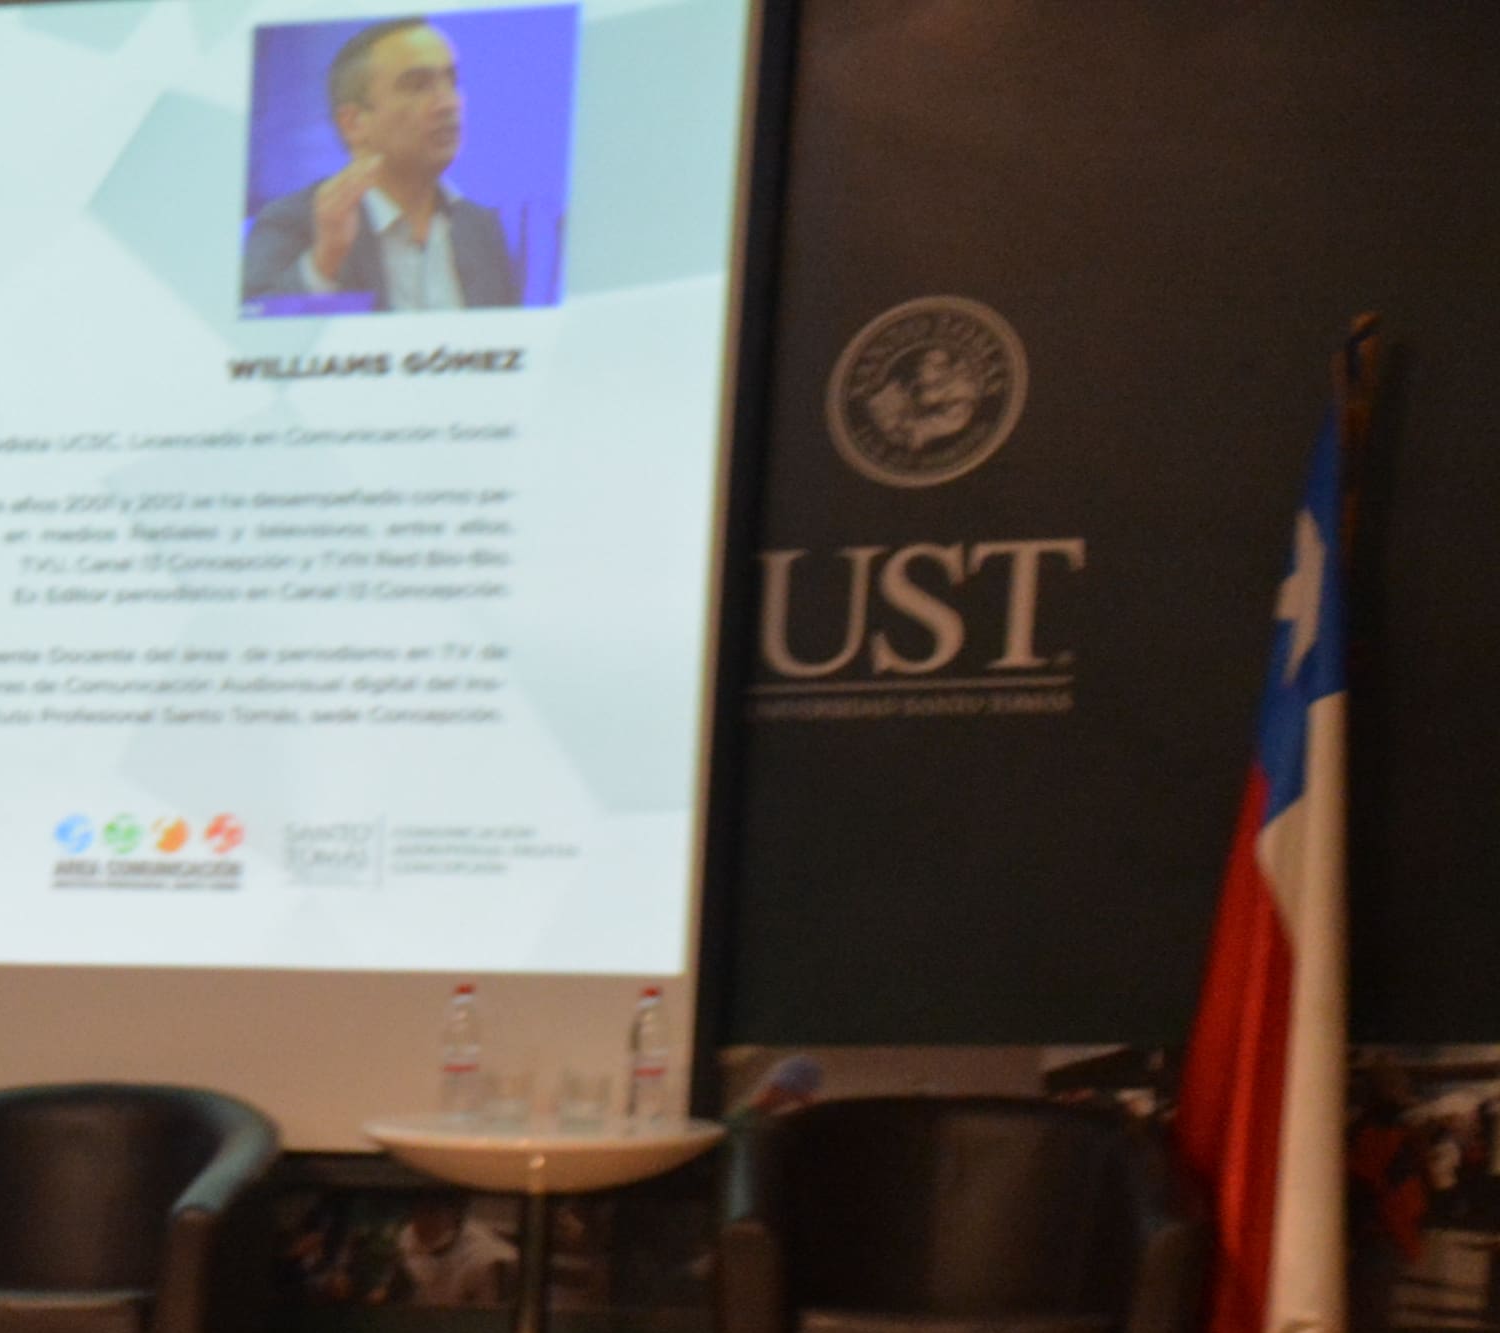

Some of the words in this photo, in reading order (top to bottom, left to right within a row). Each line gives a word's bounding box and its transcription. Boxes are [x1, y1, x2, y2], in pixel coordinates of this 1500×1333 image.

[228, 353, 390, 381] WILLIAMS
[401, 348, 526, 374] GÓMEZ
[760, 537, 1086, 678] UST
